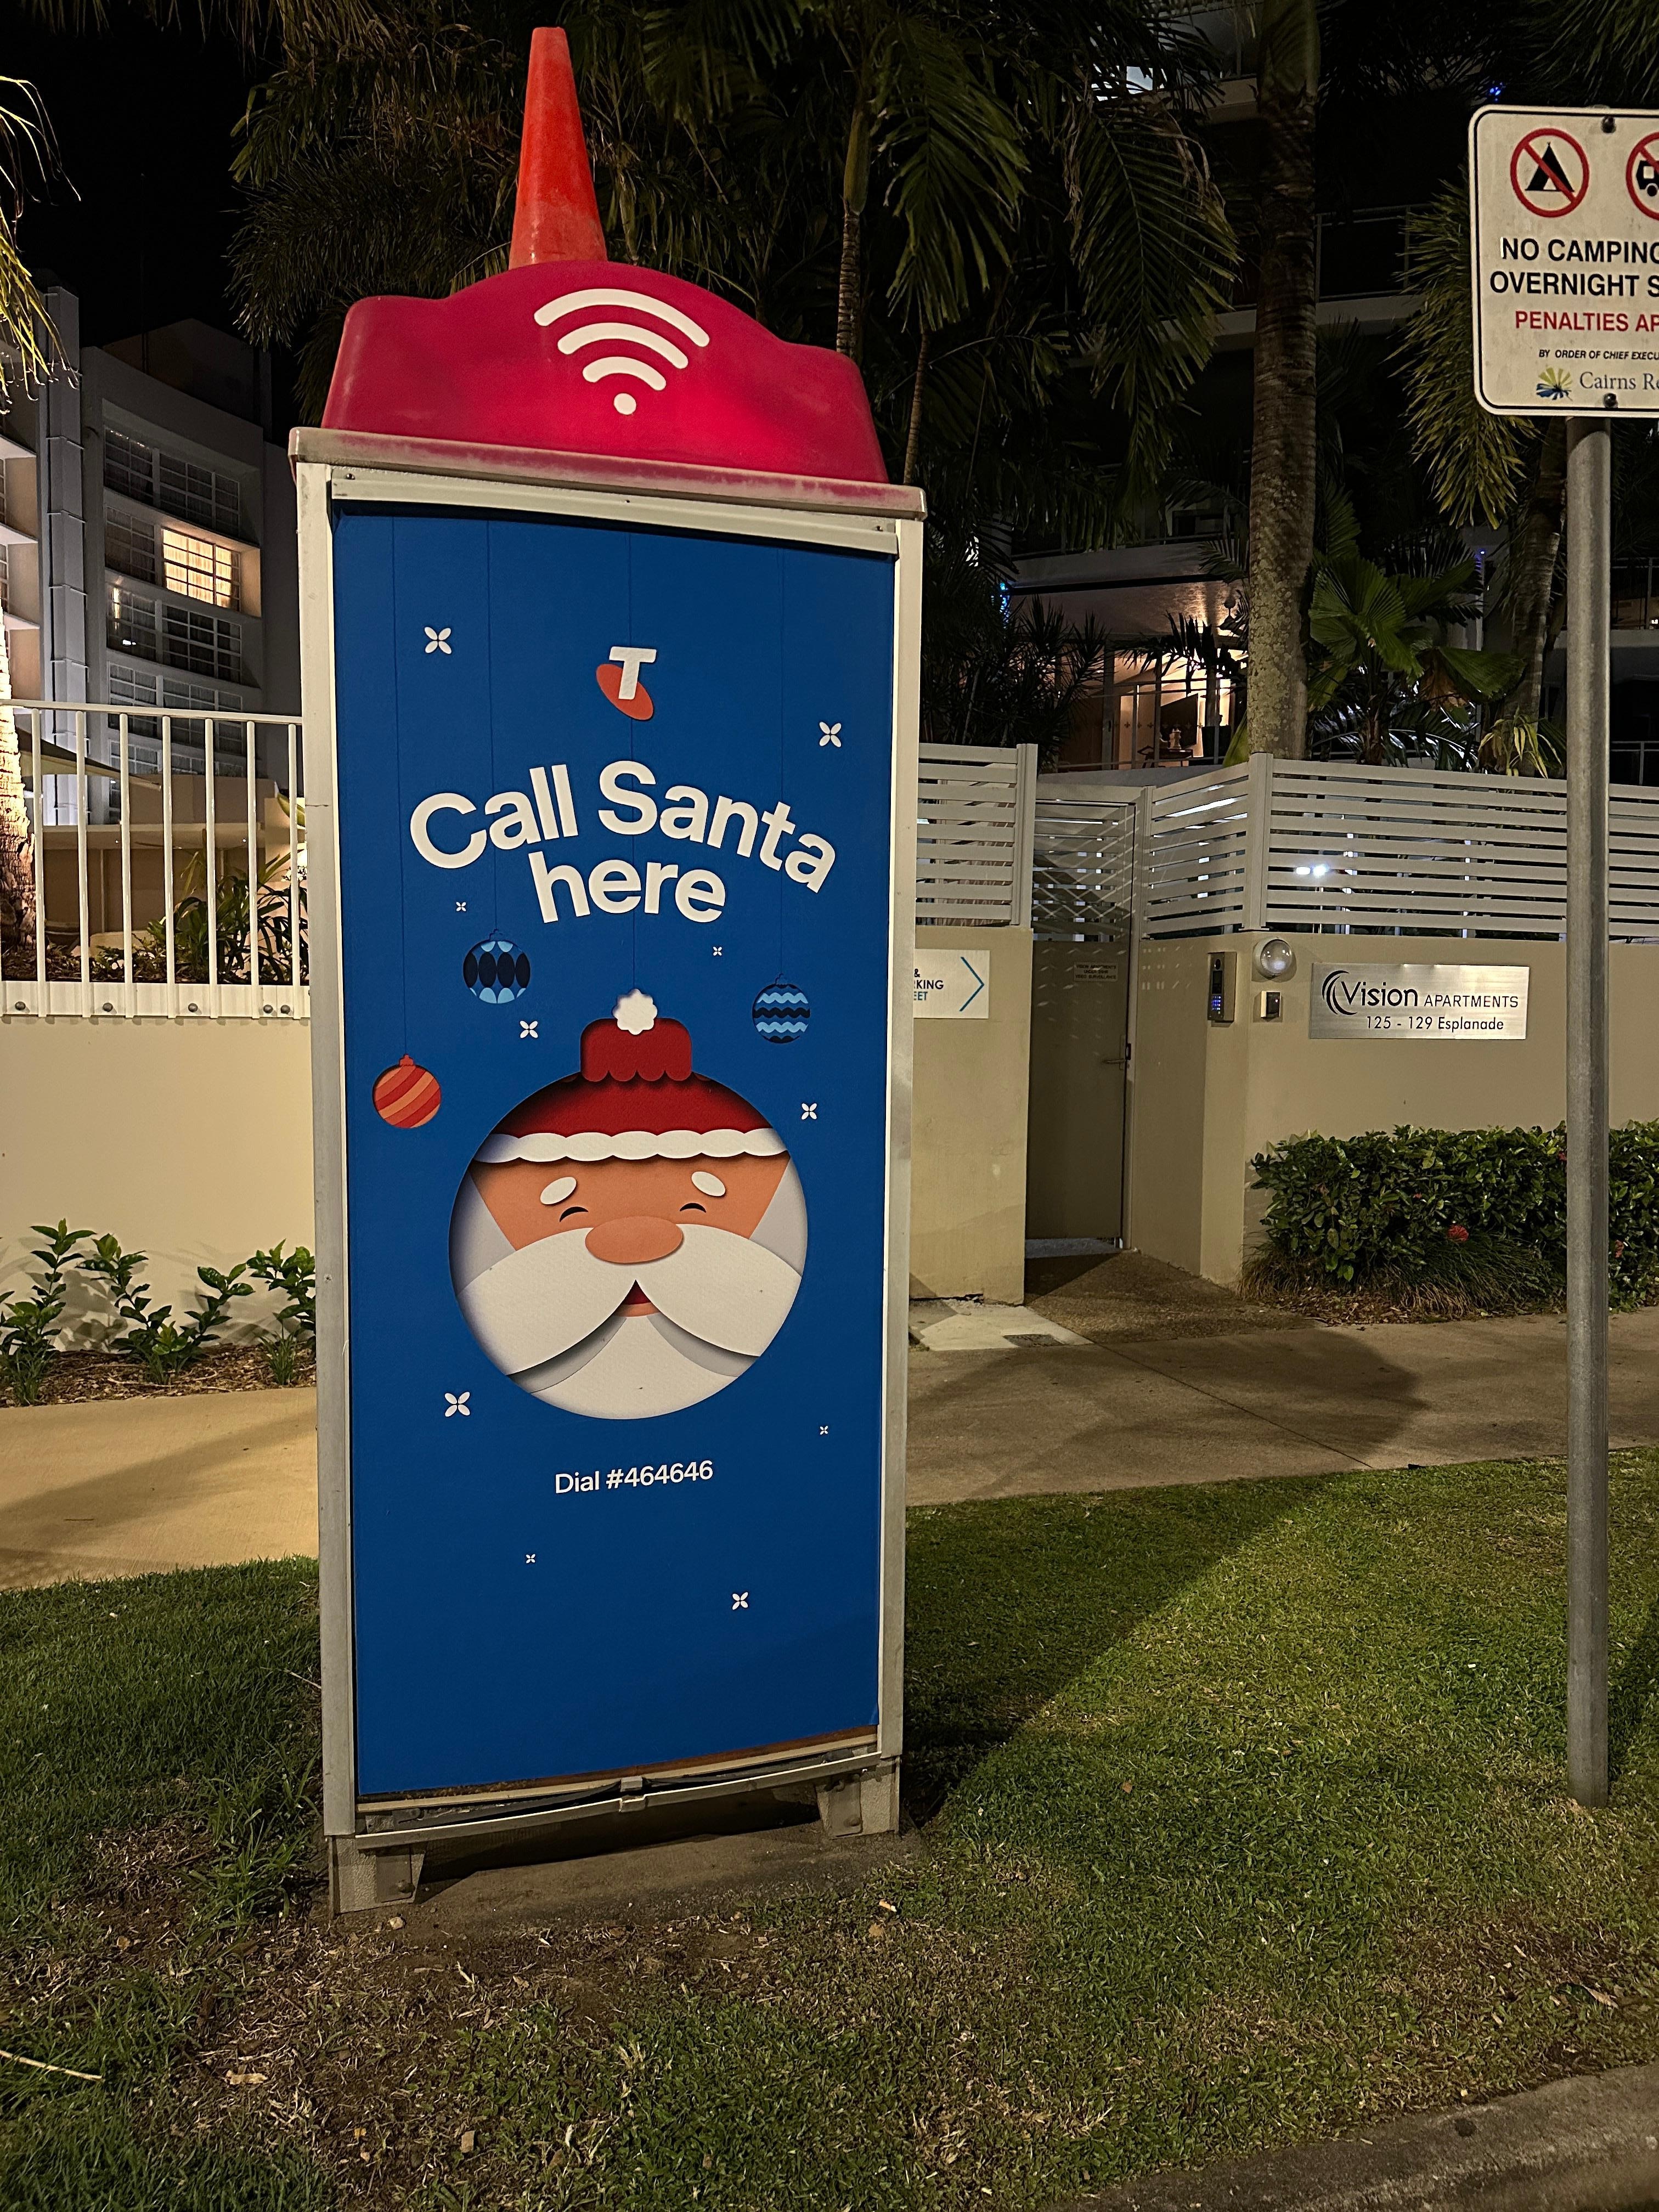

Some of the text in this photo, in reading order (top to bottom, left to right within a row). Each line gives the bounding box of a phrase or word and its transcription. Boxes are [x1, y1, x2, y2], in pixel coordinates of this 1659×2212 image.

[1502, 237, 1539, 261] NO
[1489, 270, 1640, 297] OVERNIGHT
[1515, 311, 1629, 332] PENALTIES
[1539, 349, 1550, 358] BY
[1555, 349, 1586, 359] ORDER
[1589, 350, 1601, 359] OF
[1603, 351, 1629, 360] CHIEF
[1579, 371, 1637, 390] Cairns
[410, 760, 836, 894] Call Santa
[528, 851, 726, 923] here
[914, 968, 921, 978] &
[913, 979, 944, 990] KING
[1341, 981, 1519, 1008] Vision APARTMENTS
[1367, 1016, 1391, 1029] 125
[1408, 1017, 1432, 1030] 129
[1438, 1017, 1504, 1033] Esplanade
[555, 1460, 713, 1494] Dial #464646
